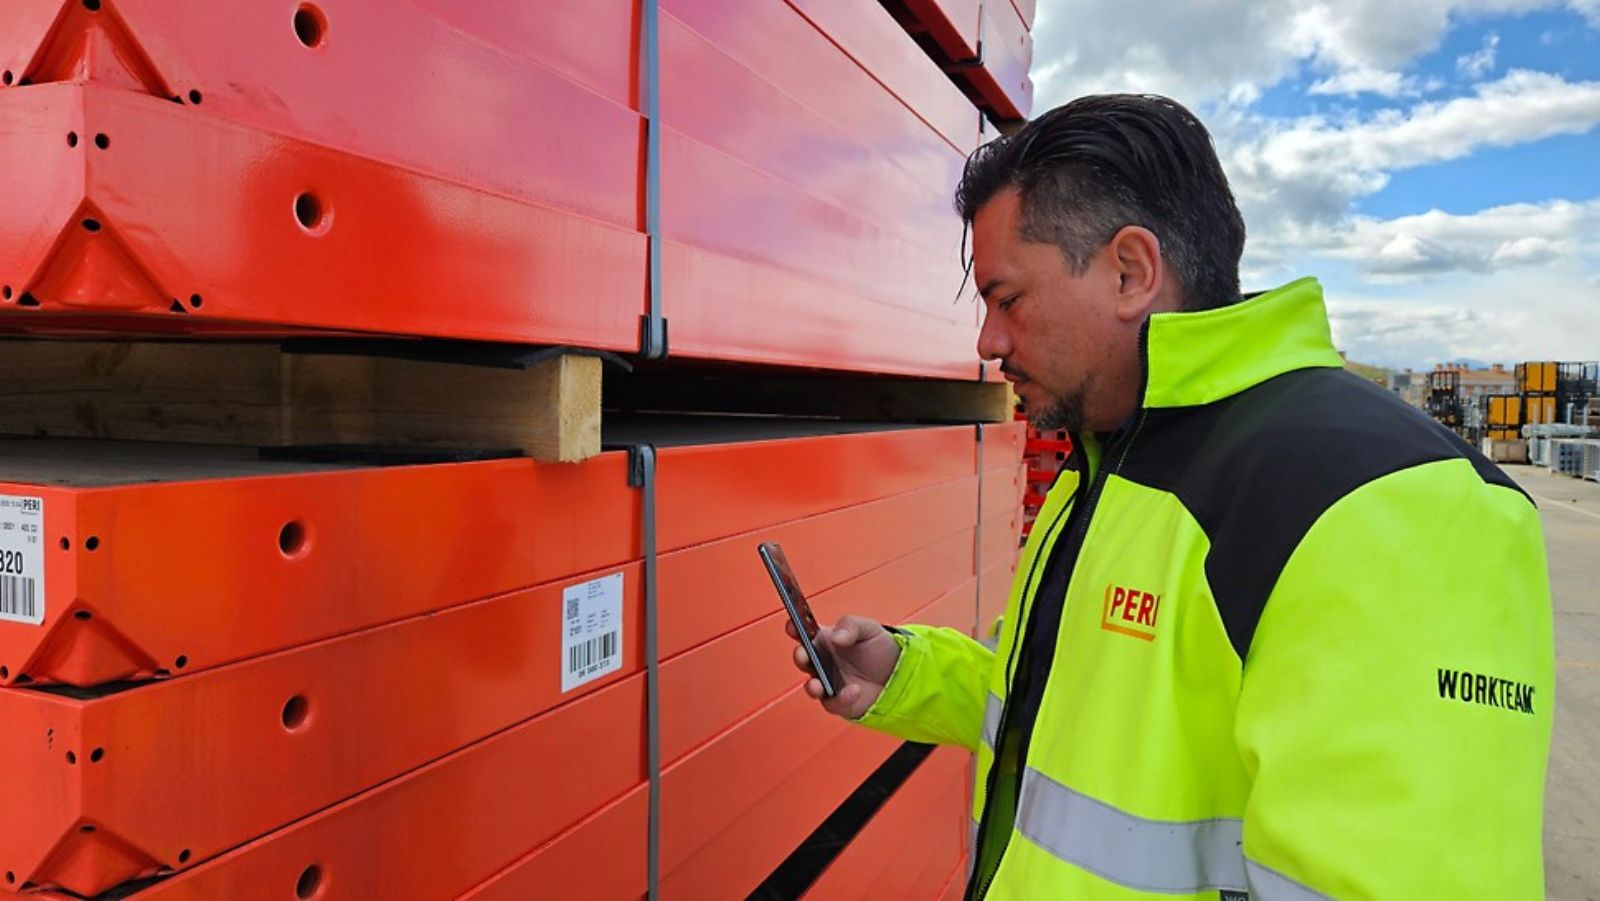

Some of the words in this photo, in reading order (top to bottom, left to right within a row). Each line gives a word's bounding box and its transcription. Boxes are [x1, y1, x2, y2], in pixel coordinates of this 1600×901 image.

[23, 499, 40, 511] PERI
[1110, 586, 1161, 628] PERI
[1437, 668, 1535, 715] WORKTEAM
